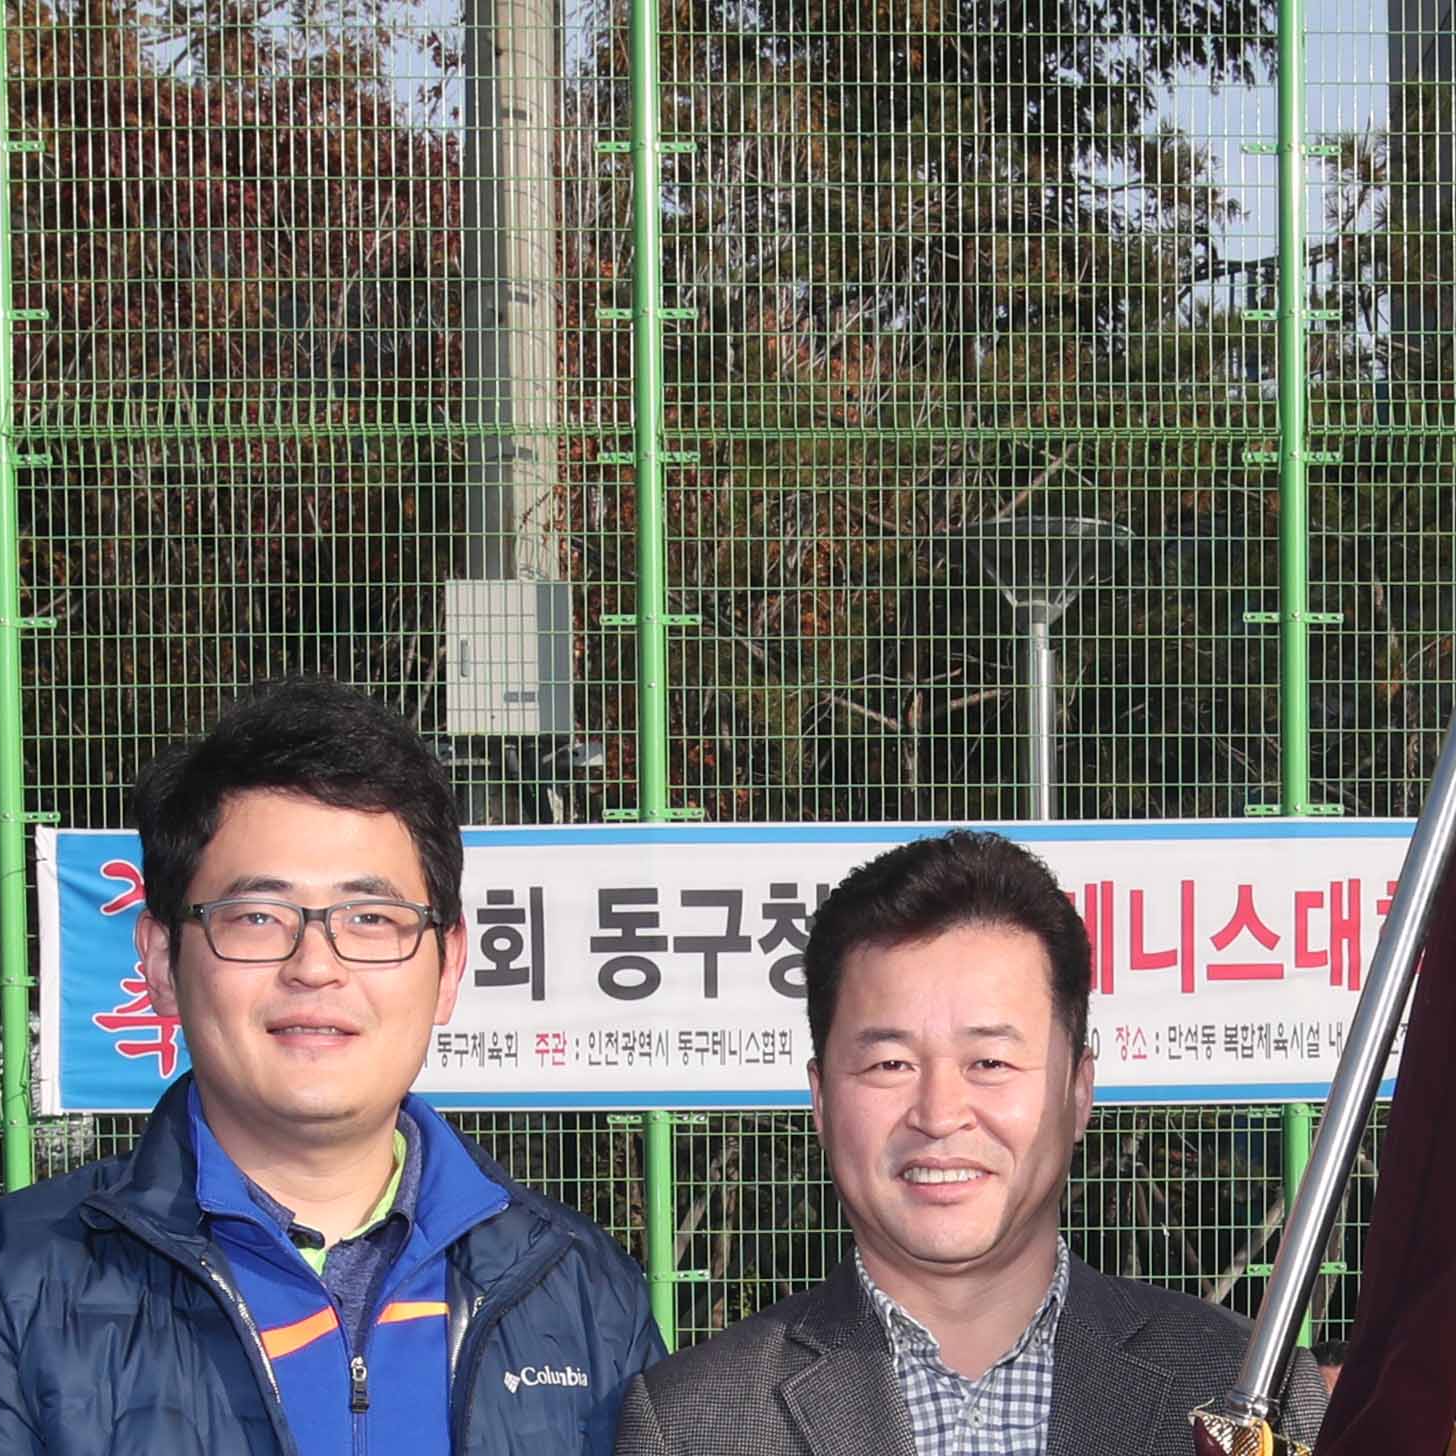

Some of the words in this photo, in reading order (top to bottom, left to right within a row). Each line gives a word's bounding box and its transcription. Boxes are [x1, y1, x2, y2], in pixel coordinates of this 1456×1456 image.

[474, 886, 546, 1001] 회
[437, 1031, 518, 1068] 동구체육회
[535, 1031, 566, 1067] 주관
[587, 1029, 670, 1067] 인천광역시
[677, 1029, 793, 1066] 동구테니스협회
[1115, 1025, 1147, 1061] 장소
[1168, 1024, 1216, 1060] 만석동
[1224, 1023, 1321, 1060] 복합체육시설
[1328, 1021, 1344, 1058] 내
